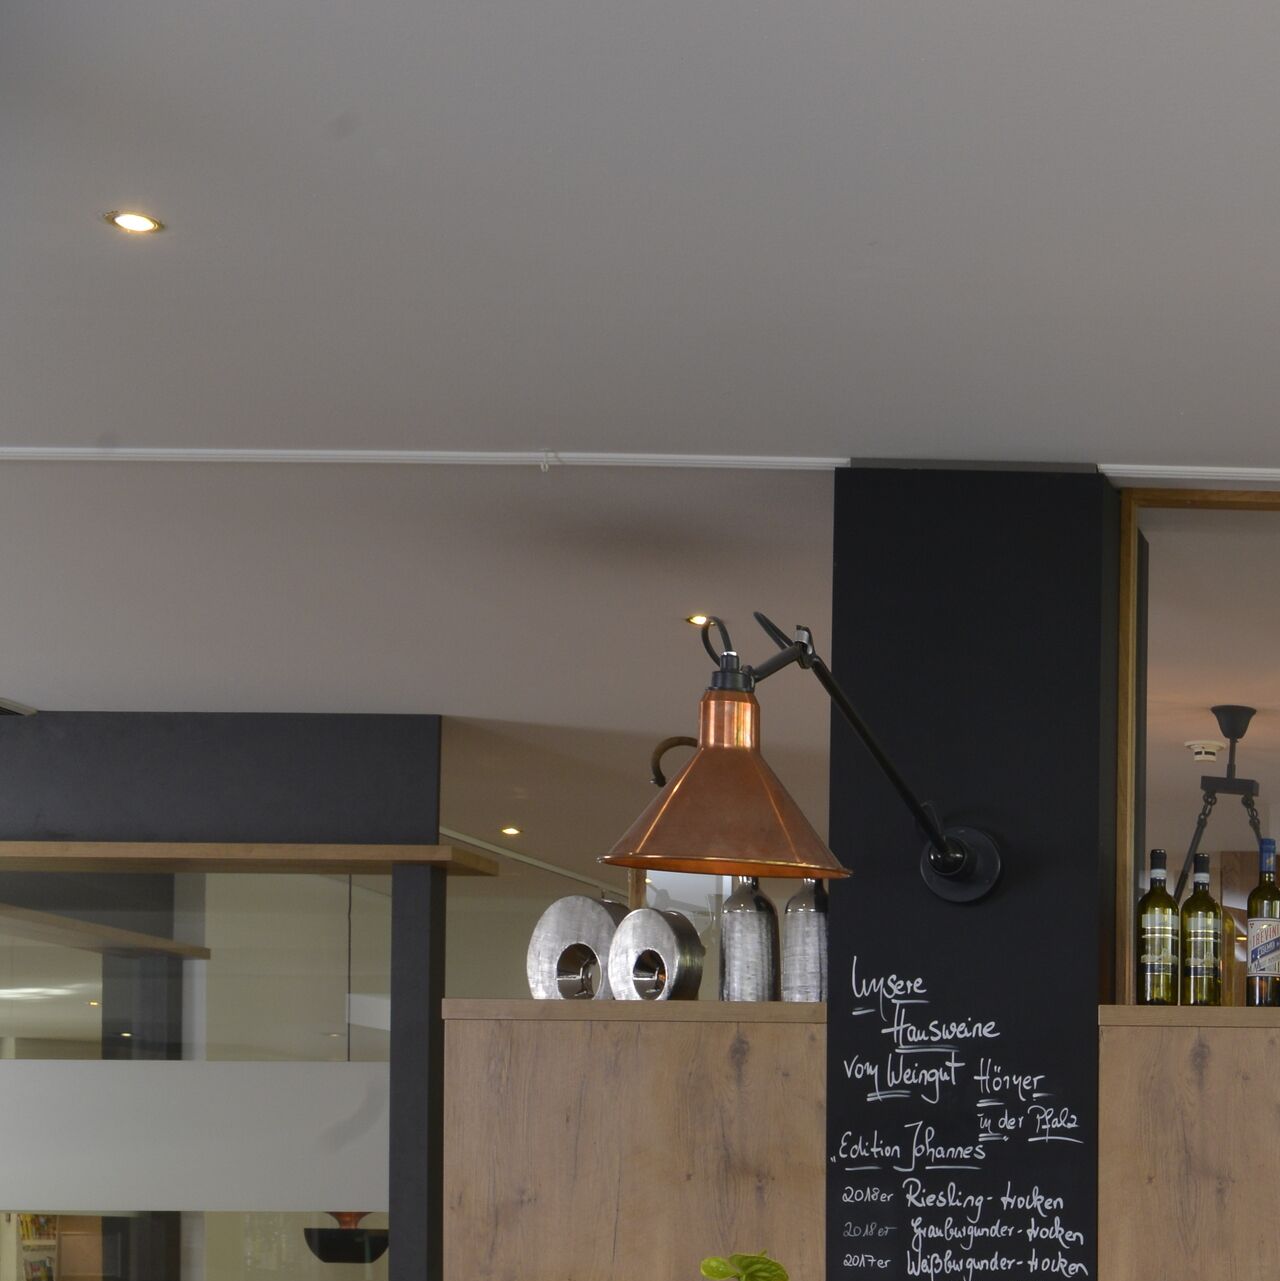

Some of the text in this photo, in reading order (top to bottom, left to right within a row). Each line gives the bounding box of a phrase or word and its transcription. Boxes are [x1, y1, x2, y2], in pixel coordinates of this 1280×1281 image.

[852, 956, 927, 1021] Unsere
[881, 1001, 1000, 1046] Hausweine
[888, 1051, 966, 1103] Weingut
[977, 1105, 1079, 1143] in der Pfalz
[842, 1186, 894, 1203] 2018er
[1001, 1181, 1064, 1218] trocken
[843, 1221, 897, 1238] 2018er
[1026, 1216, 1084, 1249] trocken
[843, 1253, 891, 1269] 2017er
[1027, 1248, 1088, 1278] trocken
